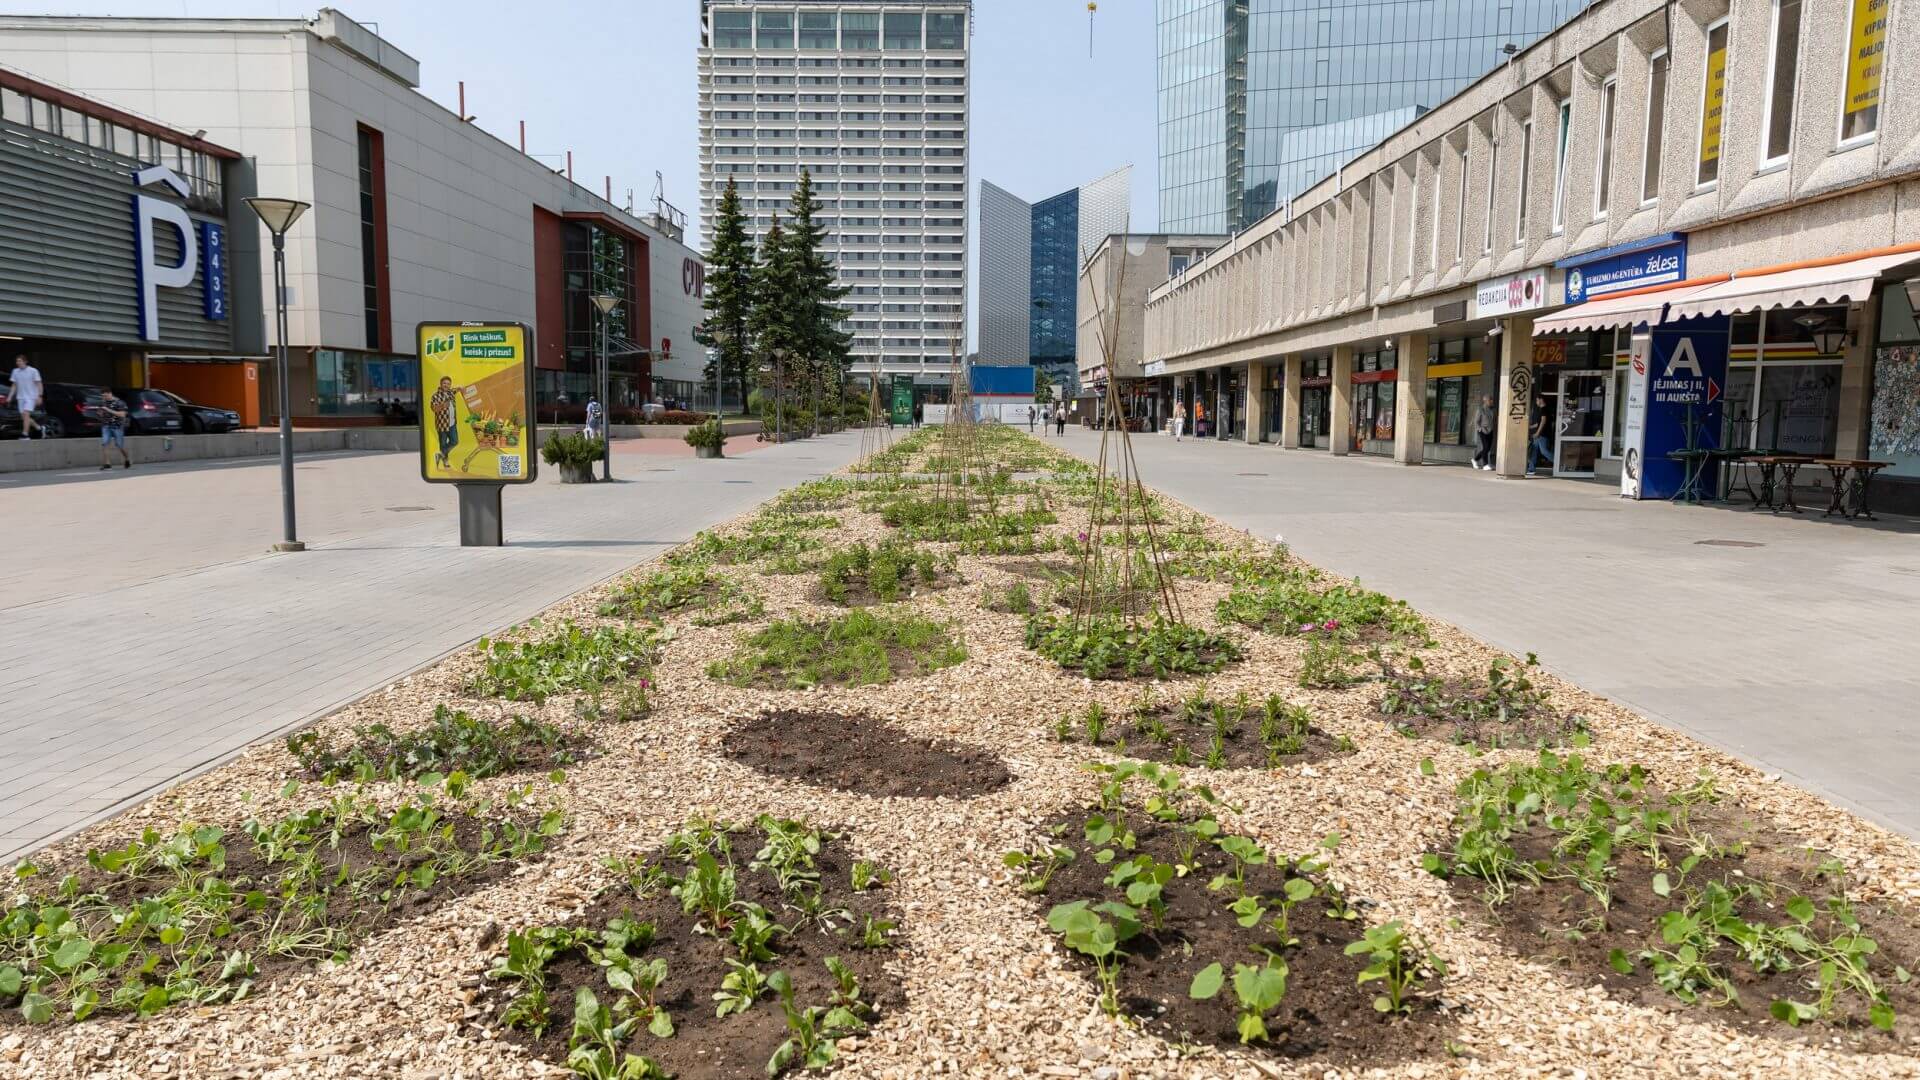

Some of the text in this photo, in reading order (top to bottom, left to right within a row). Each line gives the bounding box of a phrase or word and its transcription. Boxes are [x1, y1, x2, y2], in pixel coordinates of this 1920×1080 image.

[210, 231, 219, 247] 5
[137, 193, 198, 341] P
[211, 254, 220, 269] 4
[1585, 255, 1679, 286] TURIZMO AGENTŪRA želesa
[213, 276, 221, 292] 3
[1478, 287, 1507, 306] REDAKCIJA
[214, 299, 222, 314] 2
[425, 333, 455, 356] iki
[1663, 337, 1703, 377] A
[1653, 378, 1688, 392] ĮĖJIMAS
[1656, 393, 1665, 402] III
